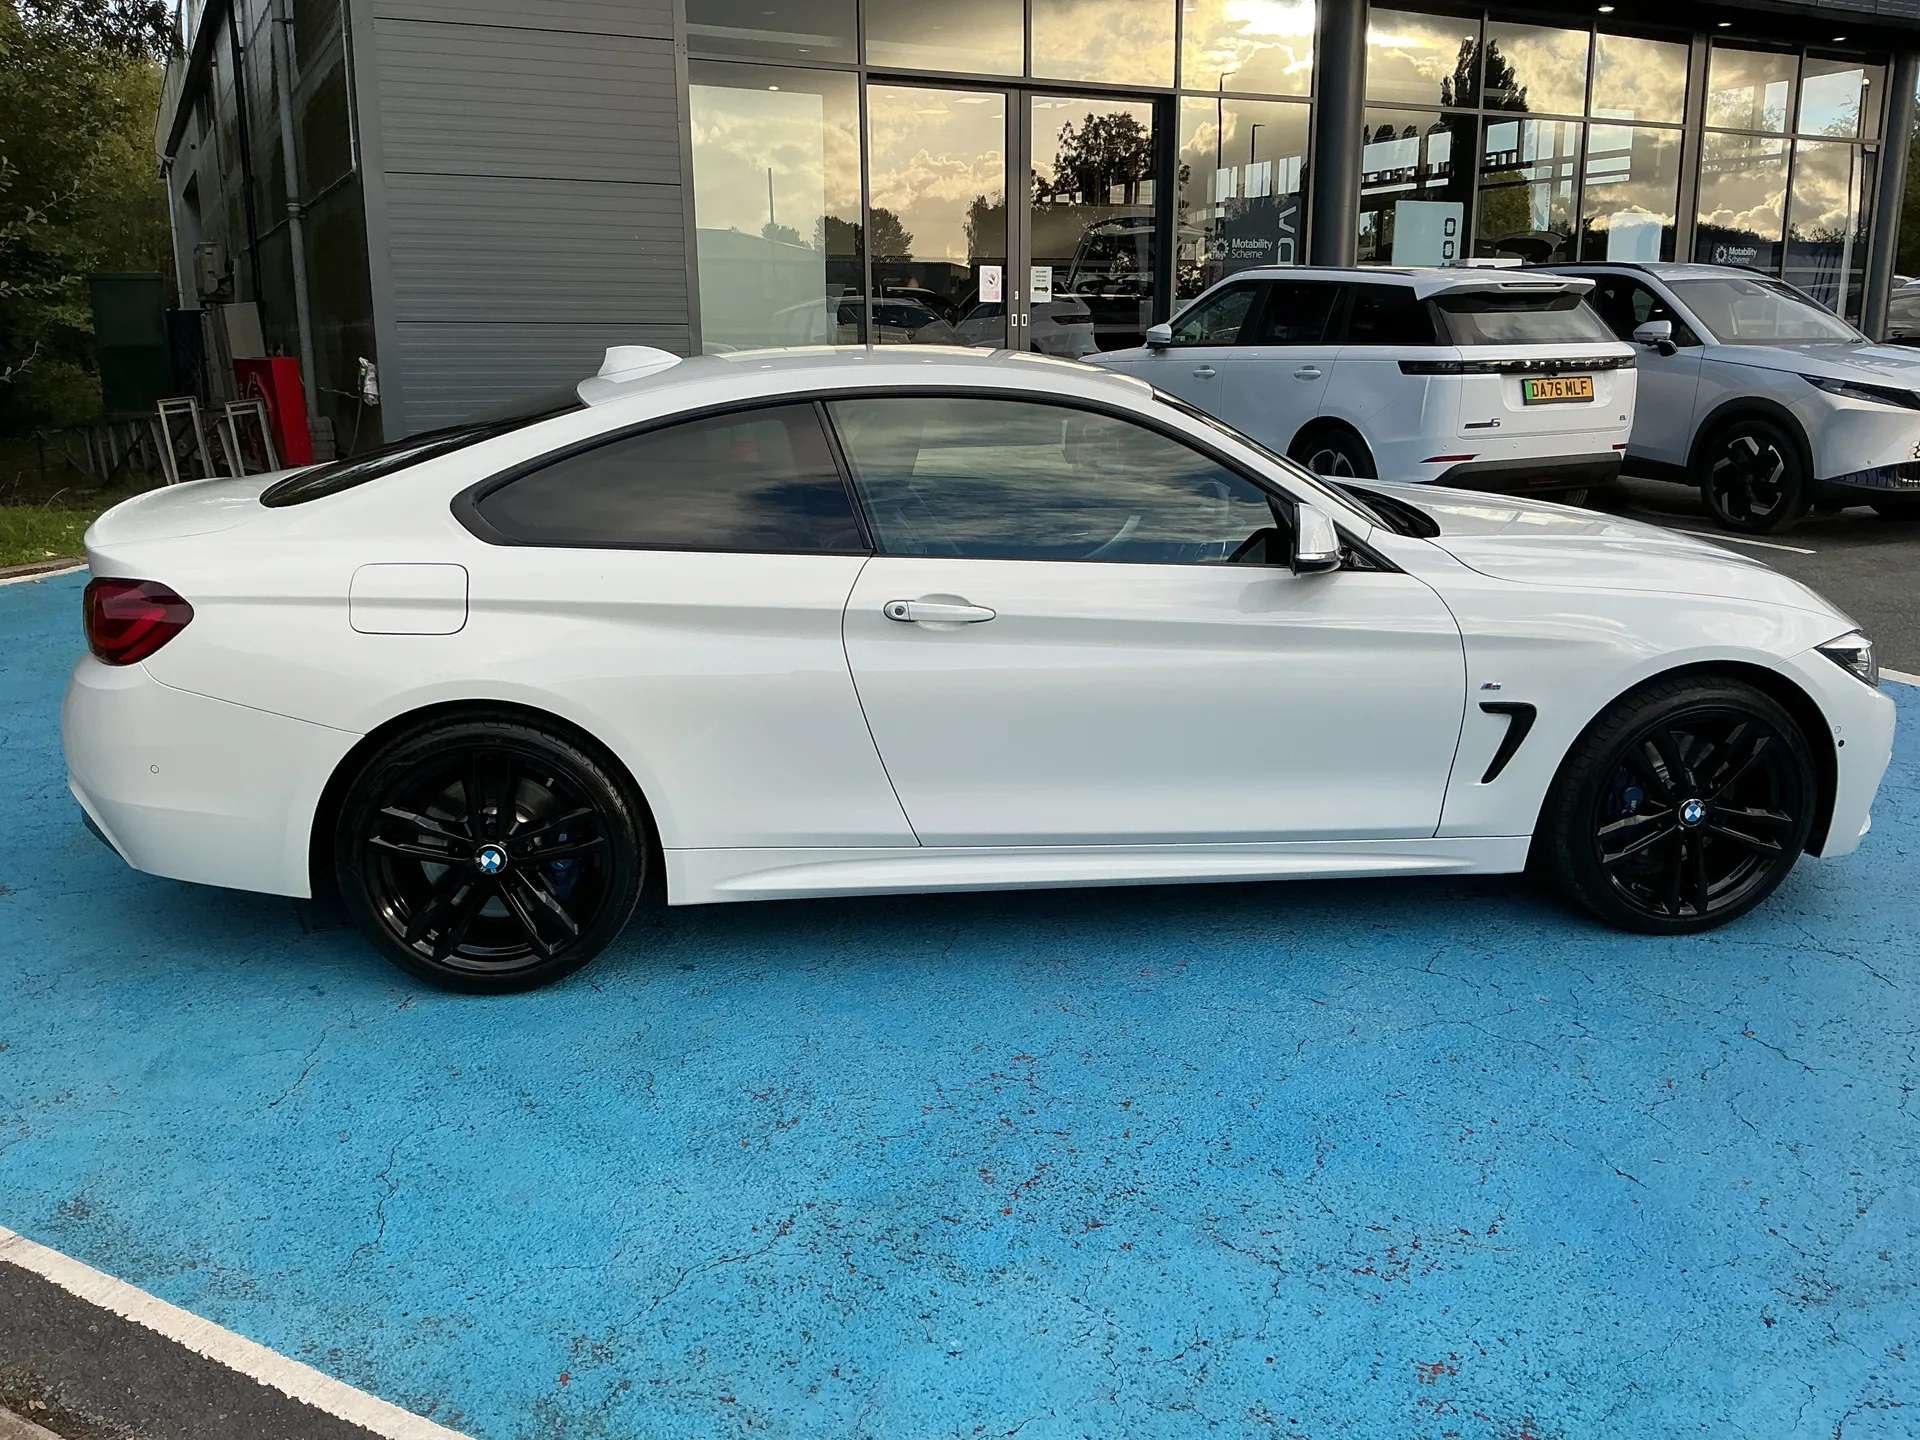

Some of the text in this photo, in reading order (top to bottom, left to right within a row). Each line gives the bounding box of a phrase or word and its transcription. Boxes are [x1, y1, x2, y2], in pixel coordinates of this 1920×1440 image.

[1231, 238, 1272, 251] Motability
[1231, 249, 1263, 259] Scheme
[1729, 247, 1757, 258] Motability
[1532, 381, 1587, 397] DA76 MLF
